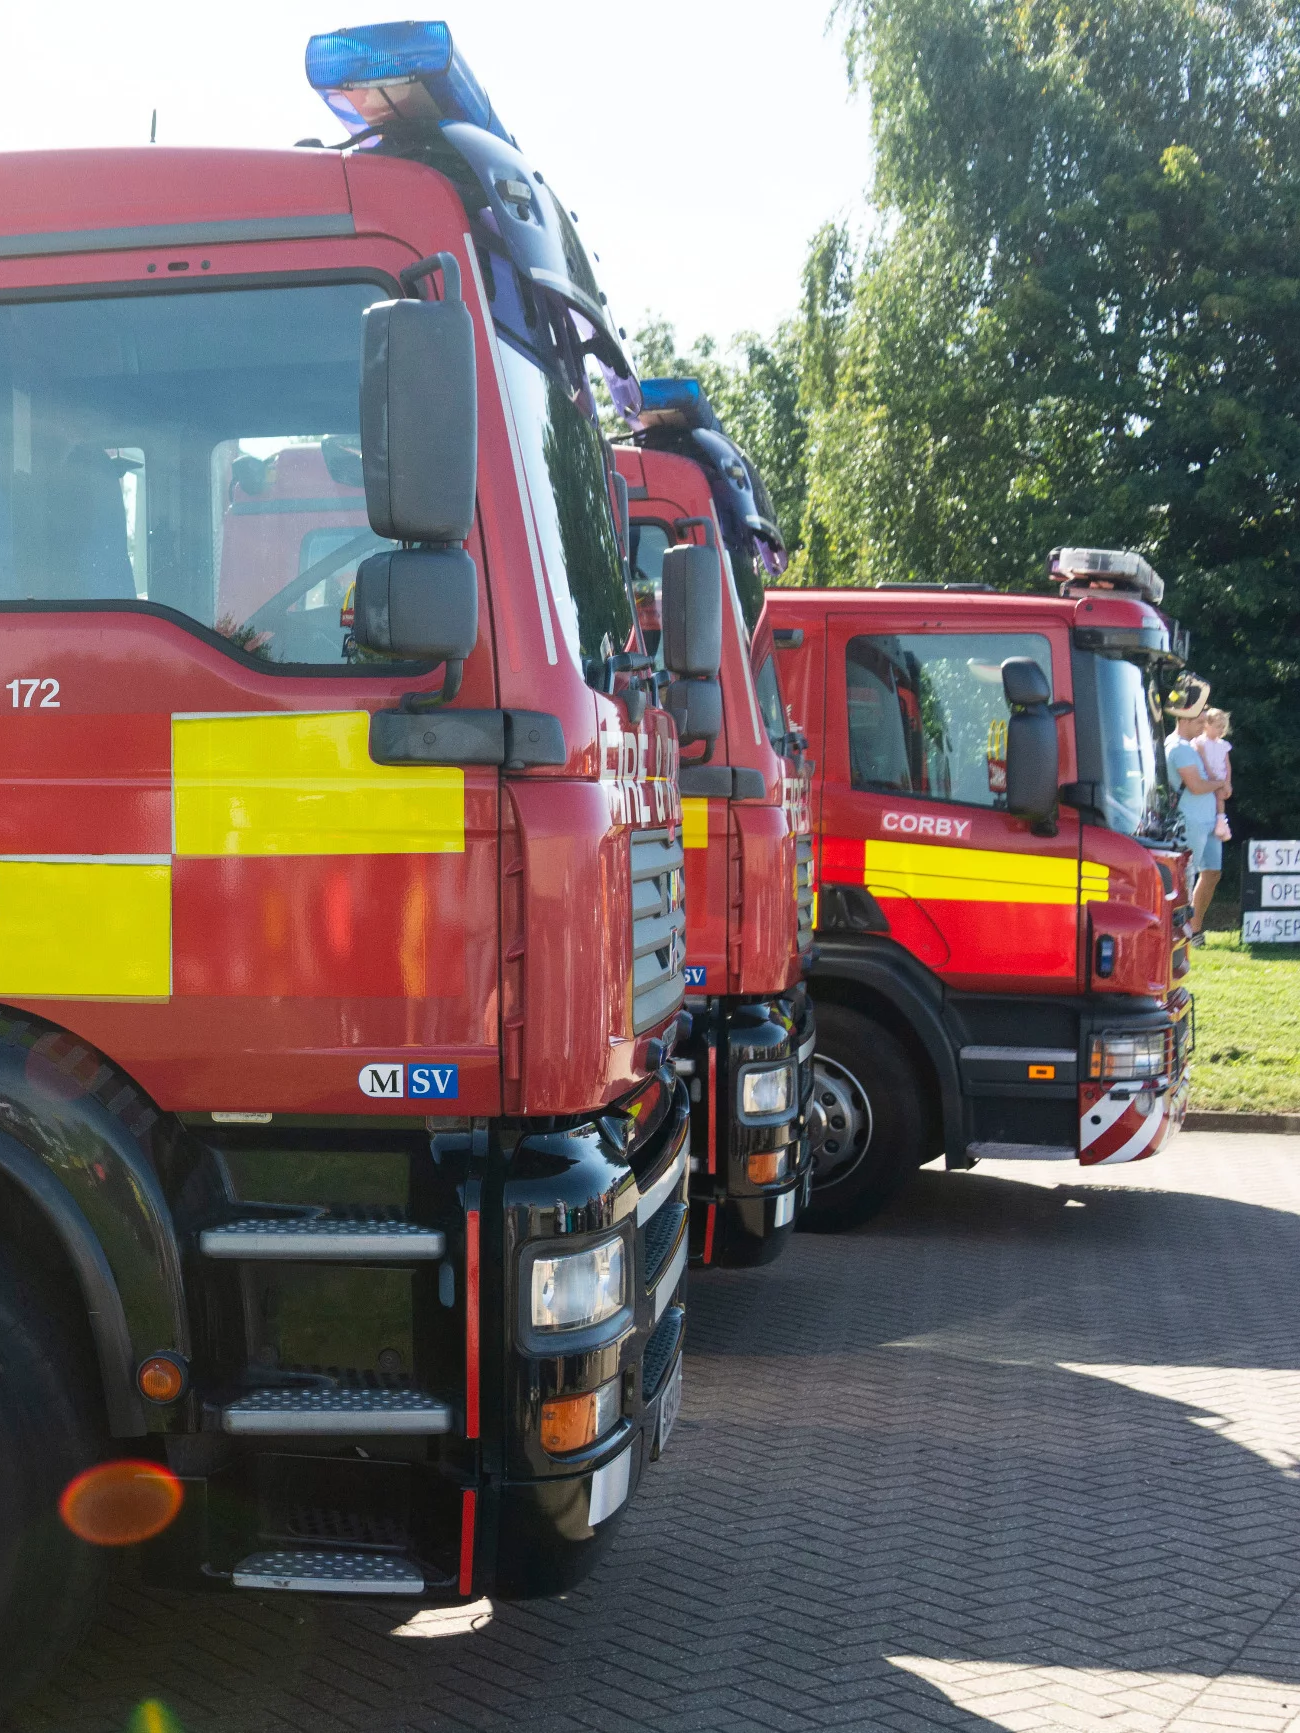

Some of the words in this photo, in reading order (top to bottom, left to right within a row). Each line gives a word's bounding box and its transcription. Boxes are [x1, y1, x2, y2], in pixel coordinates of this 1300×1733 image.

[5, 678, 61, 708] 172
[883, 812, 970, 838] CORBY
[368, 1069, 400, 1093] M
[412, 1068, 454, 1094] SV
